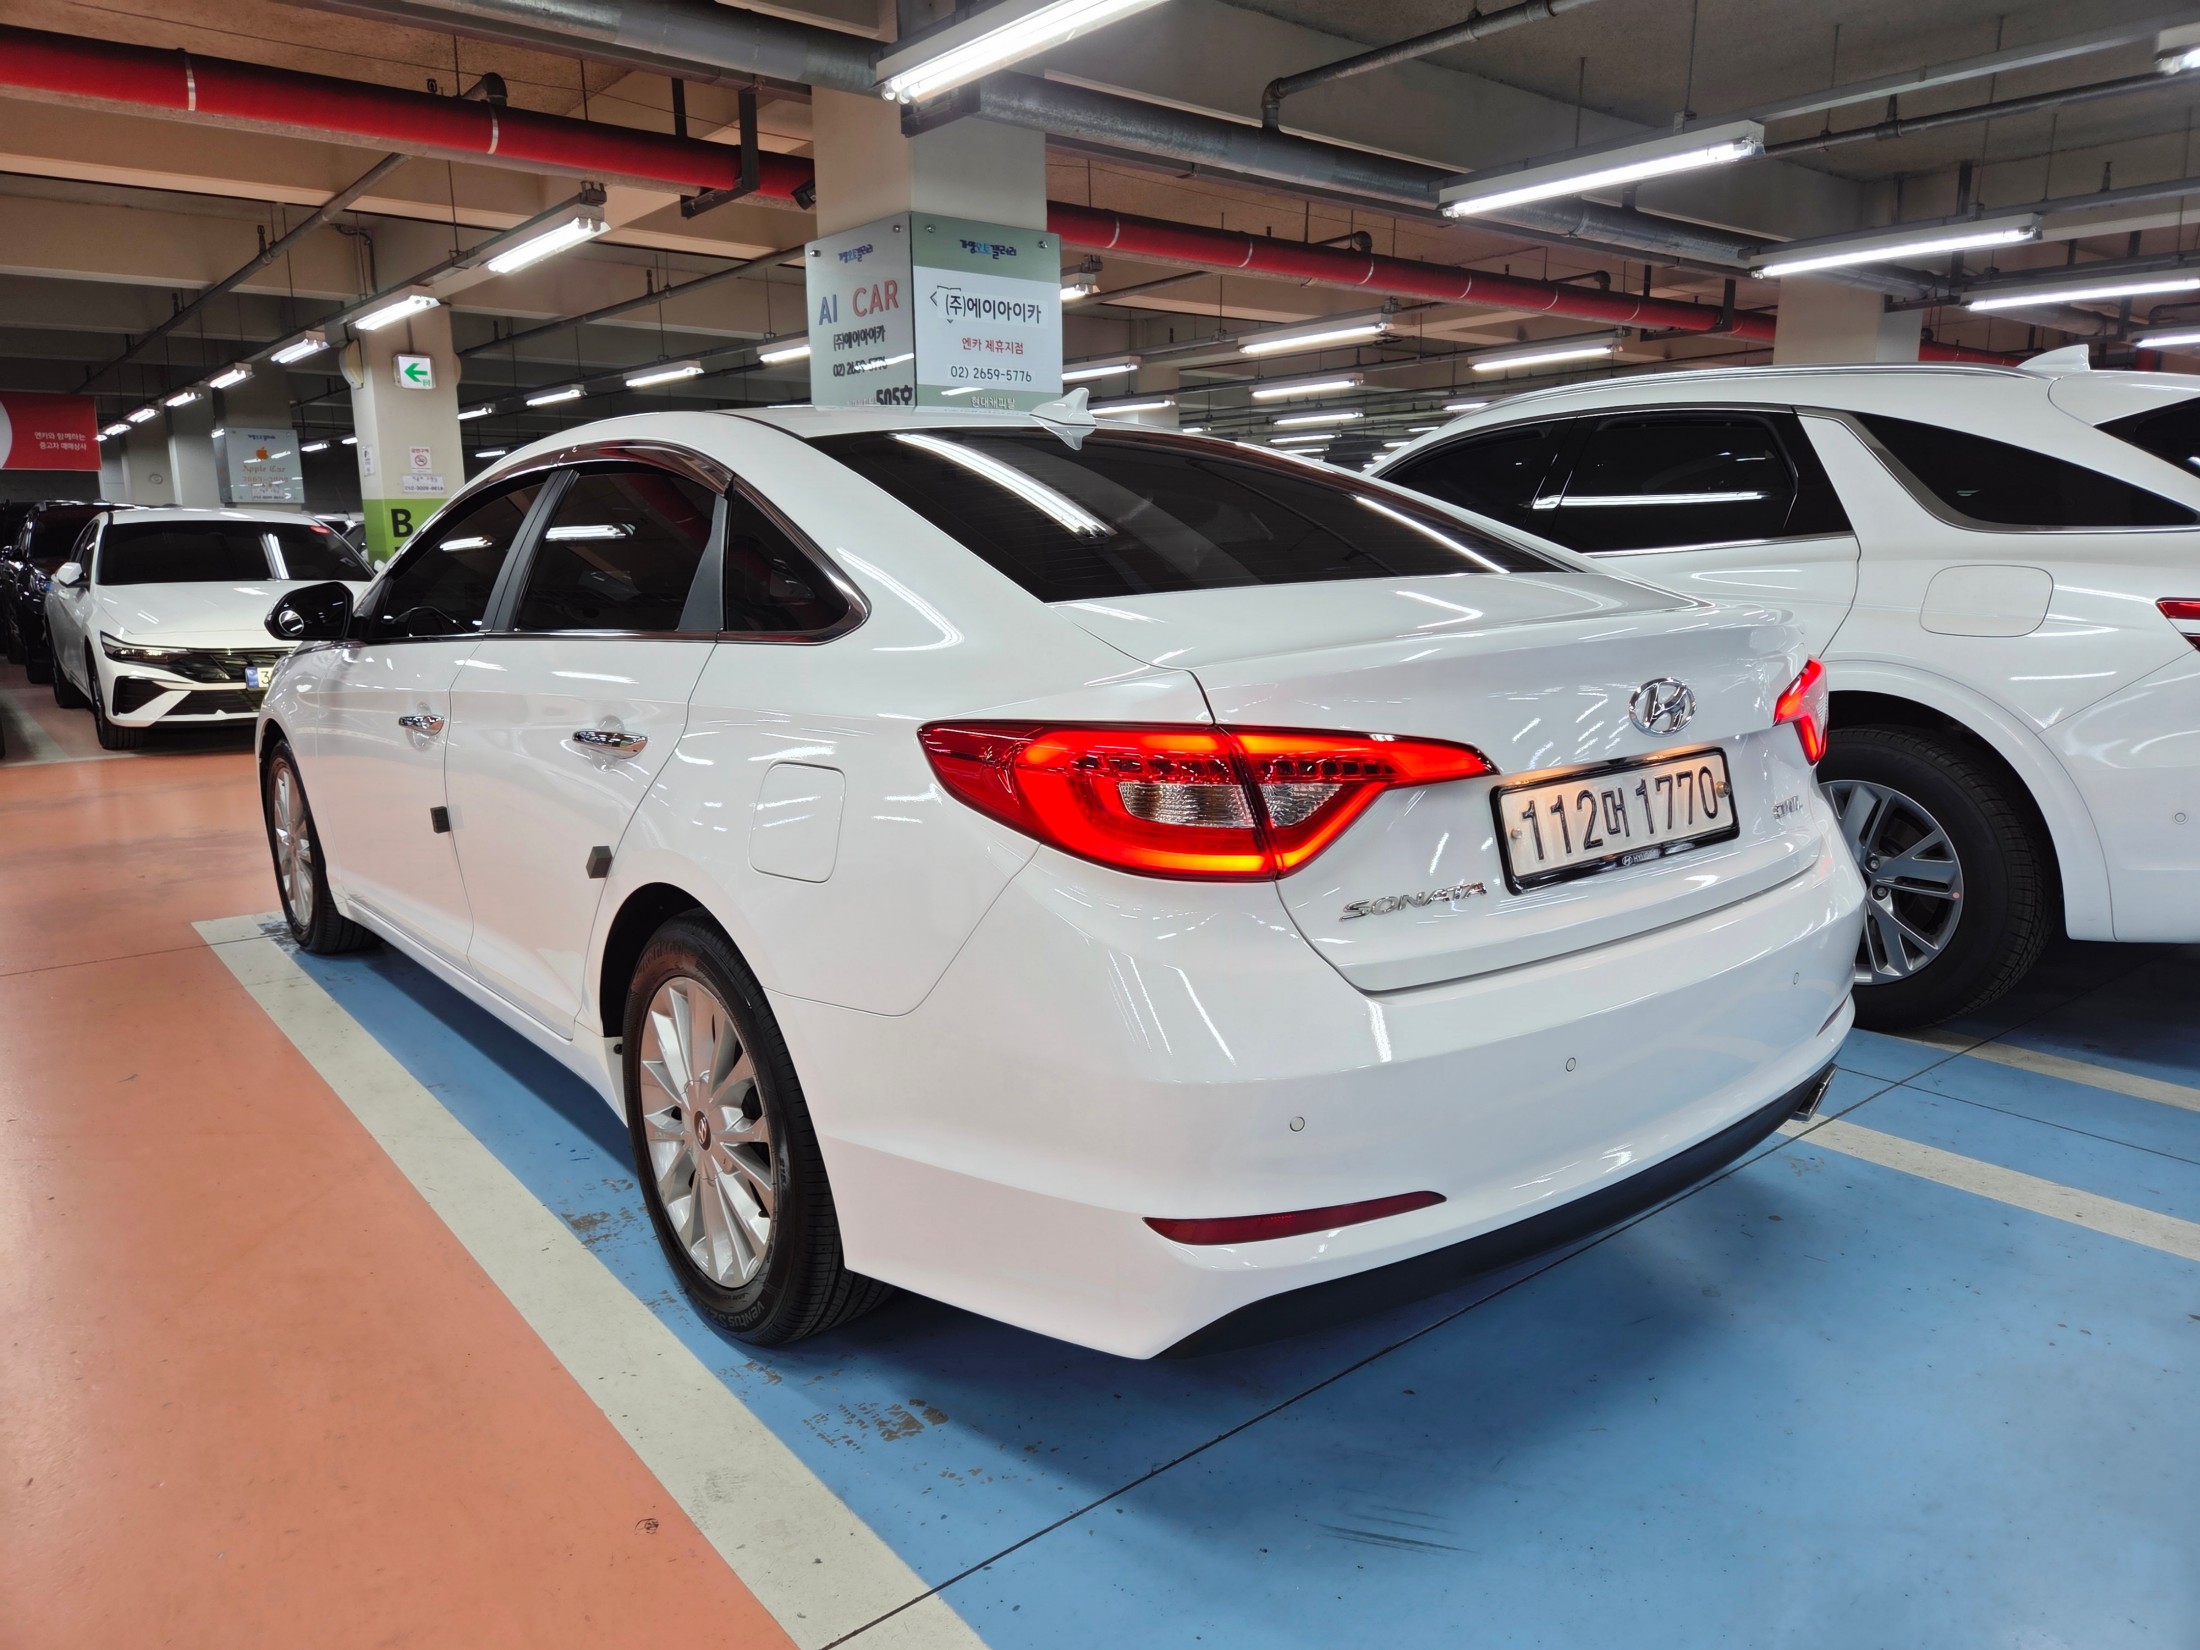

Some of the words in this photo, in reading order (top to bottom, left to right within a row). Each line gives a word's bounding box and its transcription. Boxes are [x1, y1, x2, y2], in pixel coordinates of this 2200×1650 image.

[818, 293, 838, 326] AI
[852, 279, 899, 318] CAR
[945, 293, 1042, 325] (주)에이아이카
[961, 337, 982, 352] 엔카
[985, 339, 1024, 355] 제휴지점
[950, 365, 969, 379] 02)
[973, 367, 1032, 383] 2659-5776
[390, 508, 414, 538] B
[1338, 882, 1488, 922] SONATA
